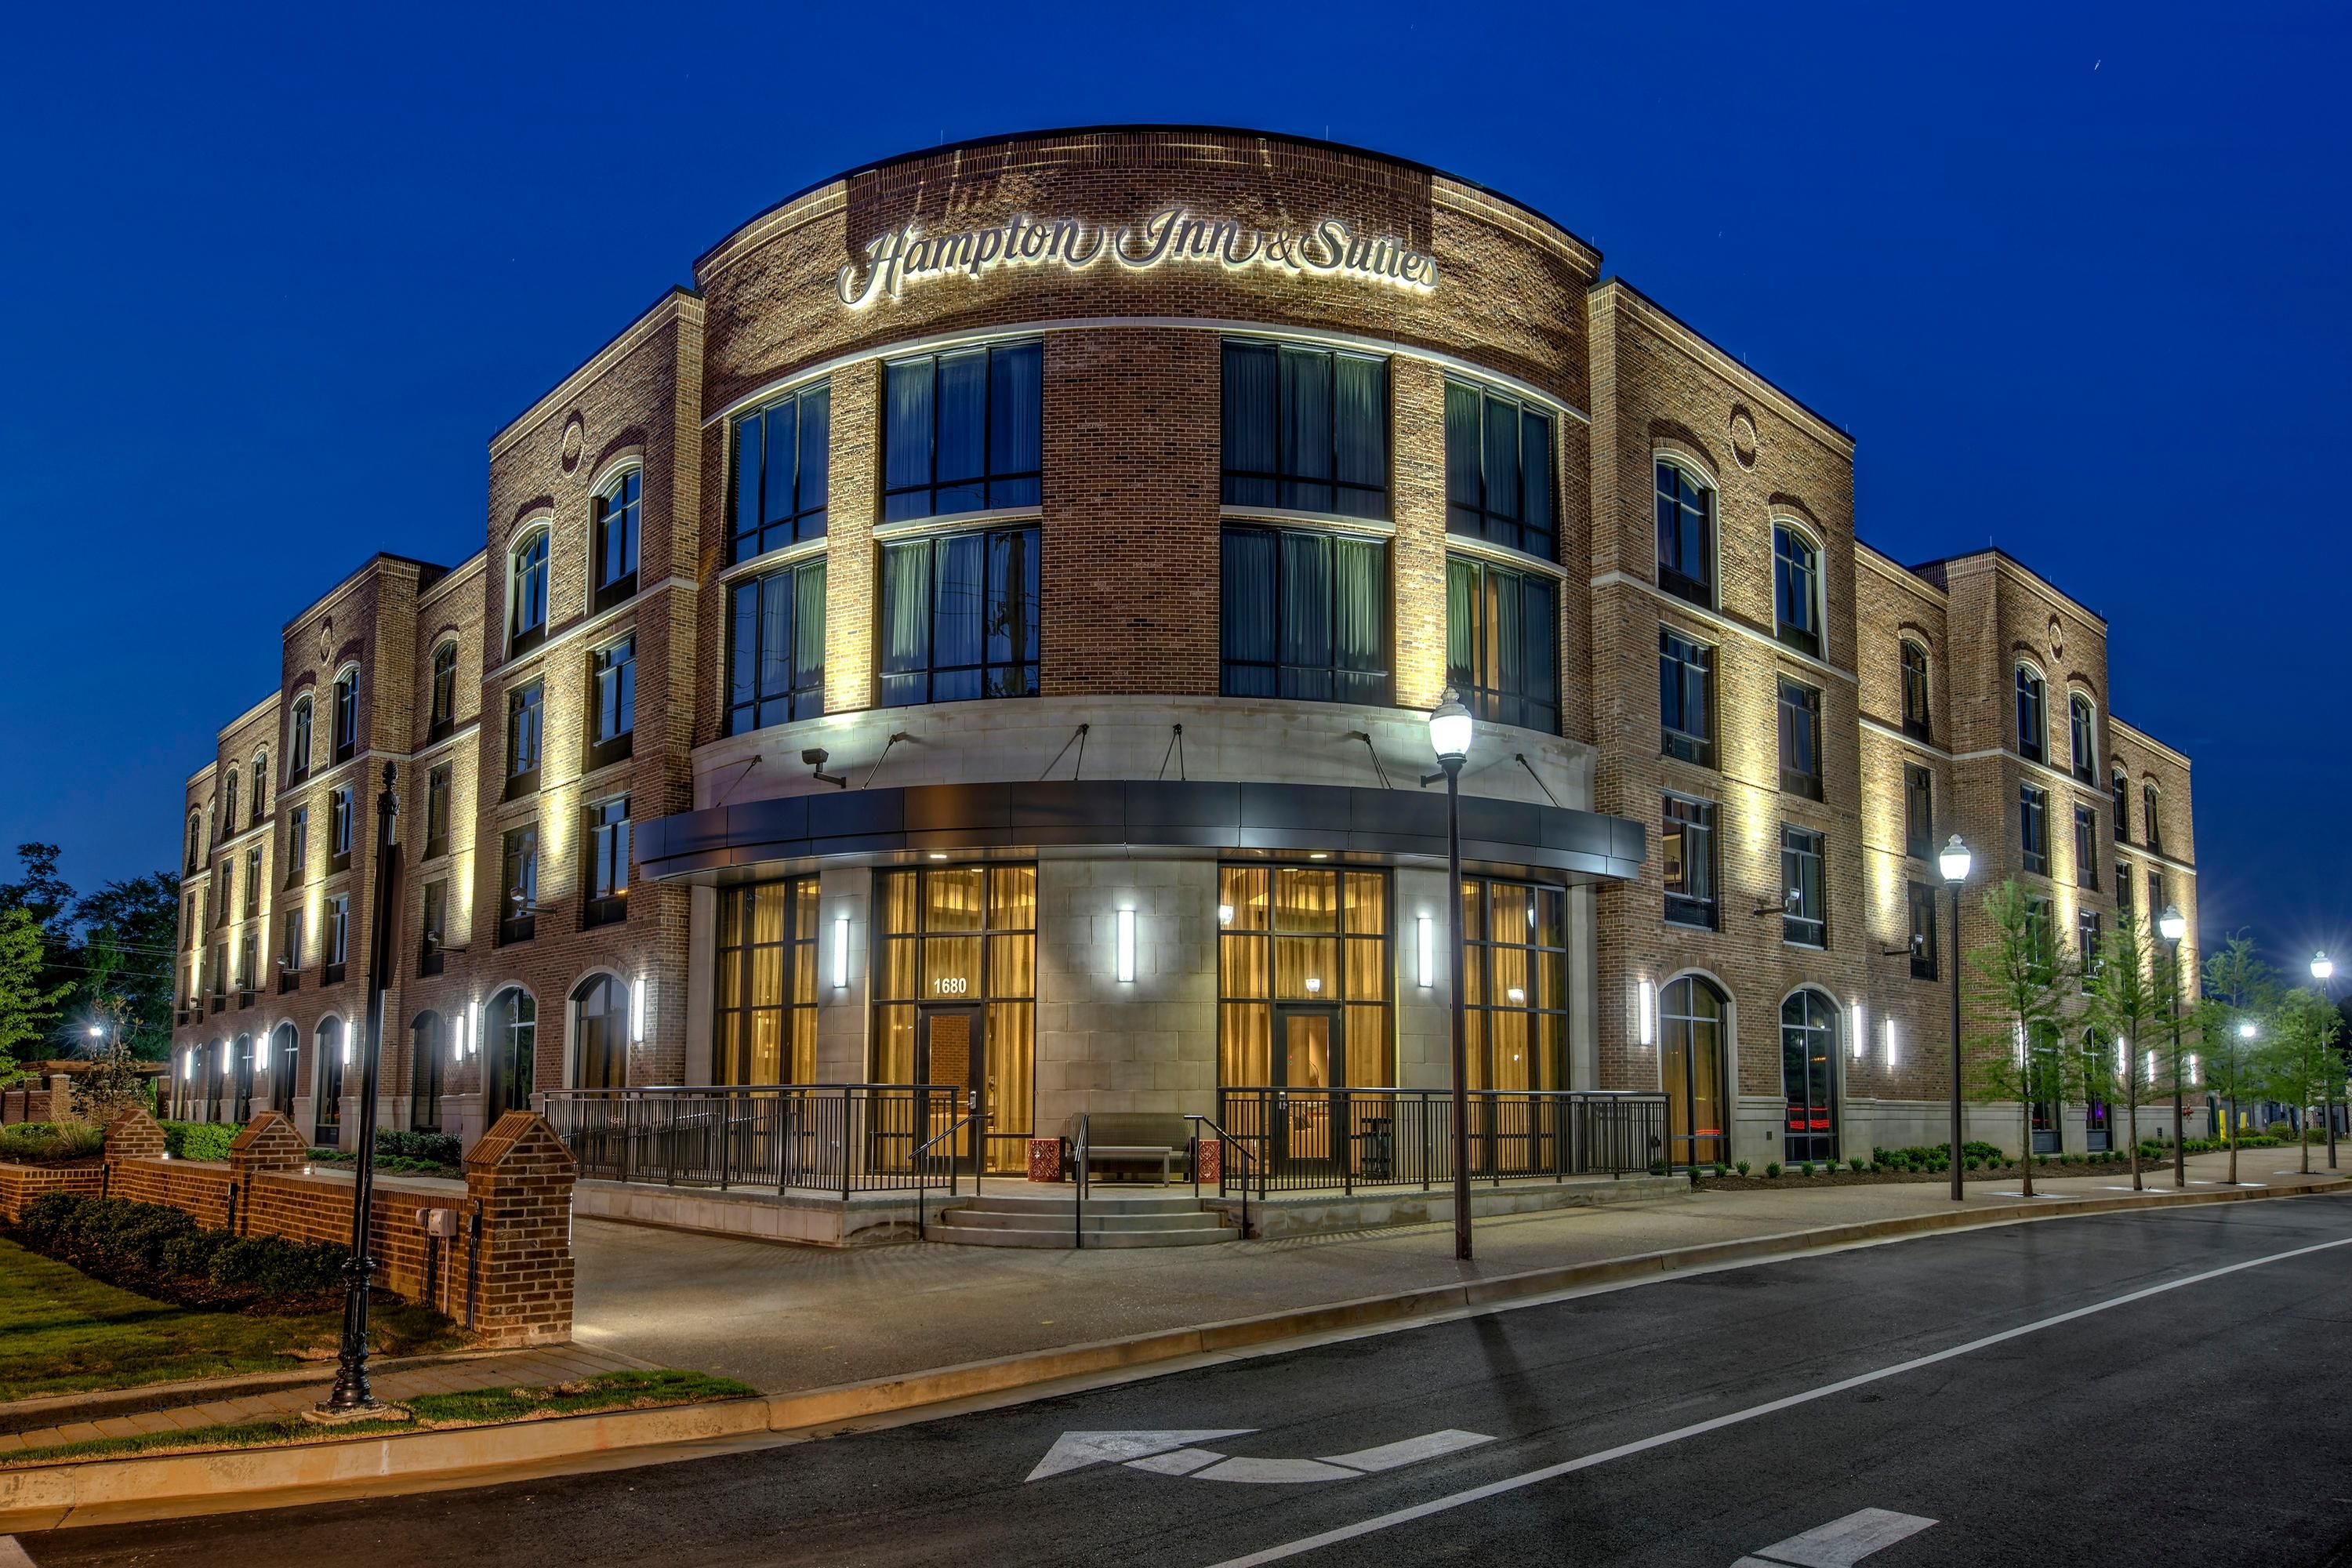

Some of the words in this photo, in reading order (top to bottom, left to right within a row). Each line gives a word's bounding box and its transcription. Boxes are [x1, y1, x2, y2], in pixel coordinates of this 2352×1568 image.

[837, 216, 1103, 304] Hampton
[1116, 208, 1262, 264] Inn
[1265, 228, 1301, 269] &
[1301, 219, 1438, 287] Suites
[934, 978, 967, 993] 1680
